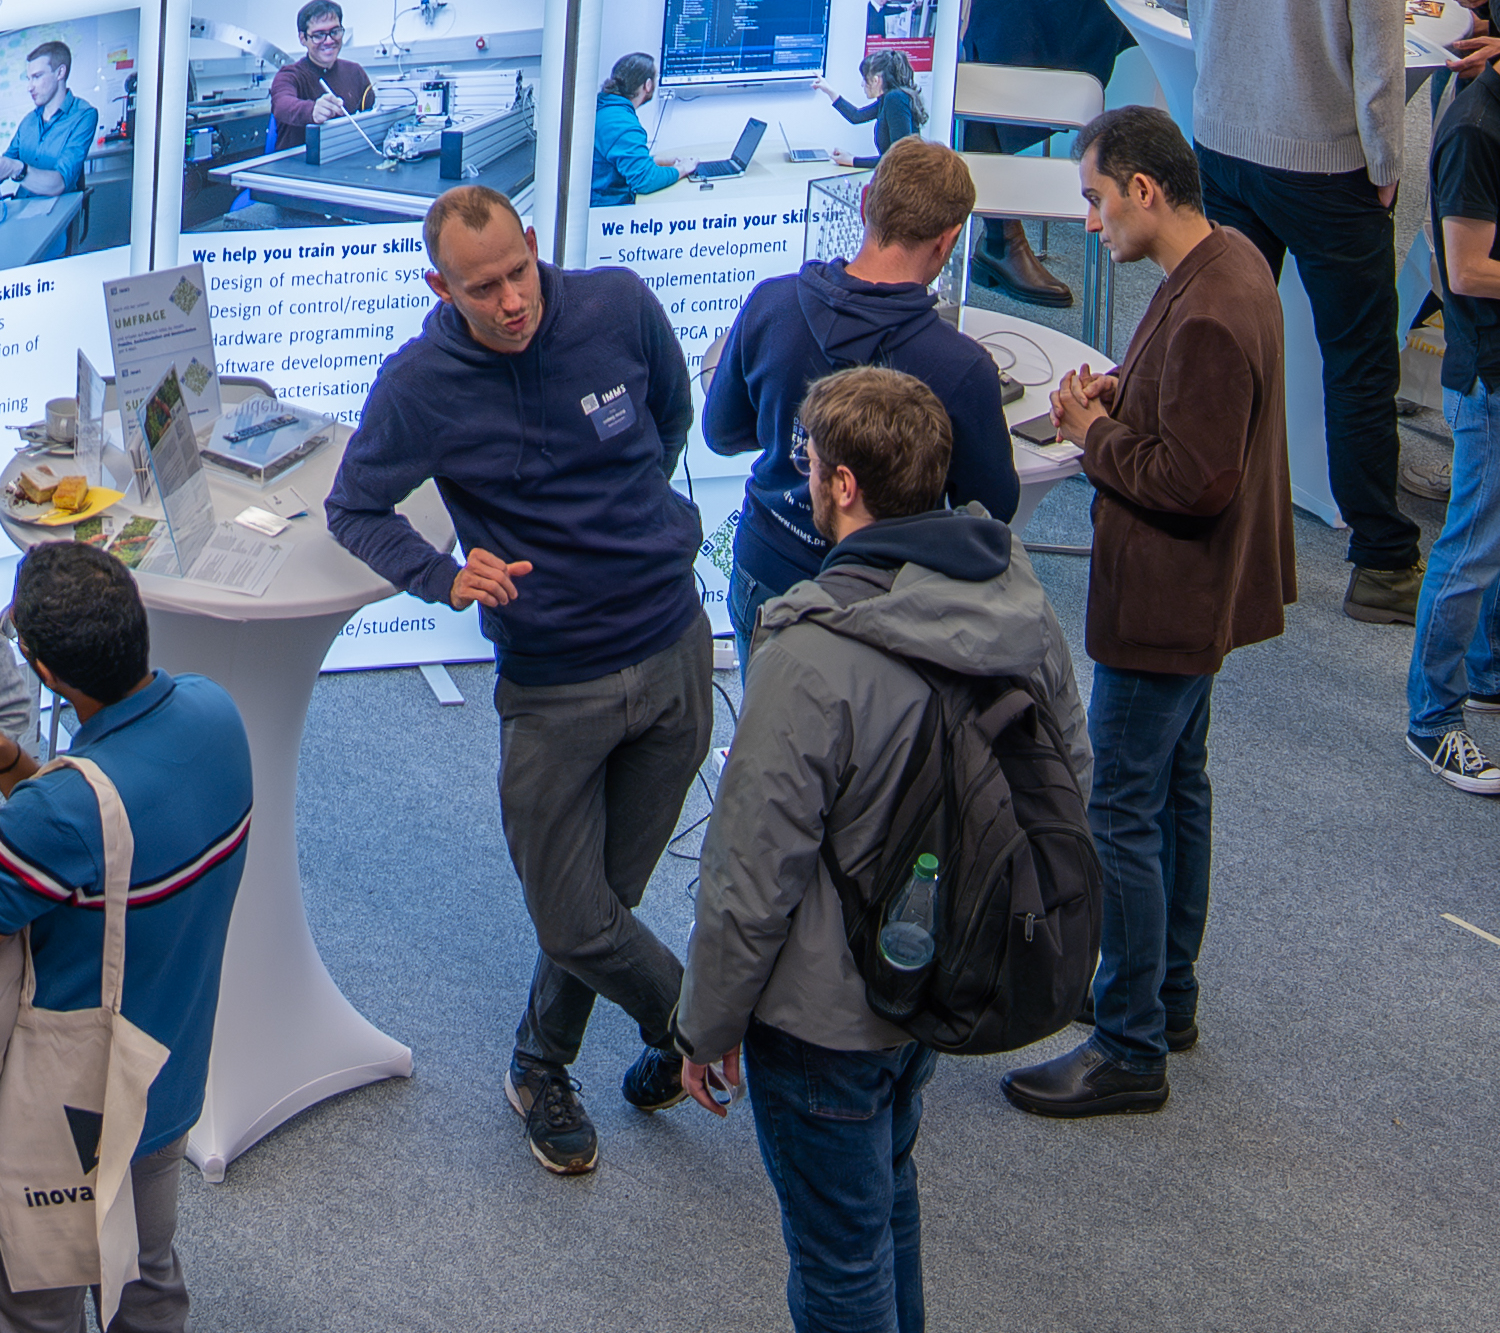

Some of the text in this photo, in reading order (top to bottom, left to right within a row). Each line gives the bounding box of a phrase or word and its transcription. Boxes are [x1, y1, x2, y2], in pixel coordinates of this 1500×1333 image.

[114, 309, 166, 330] UMFRAGE
[601, 383, 626, 403] IMMS
[25, 1185, 96, 1208] inova
